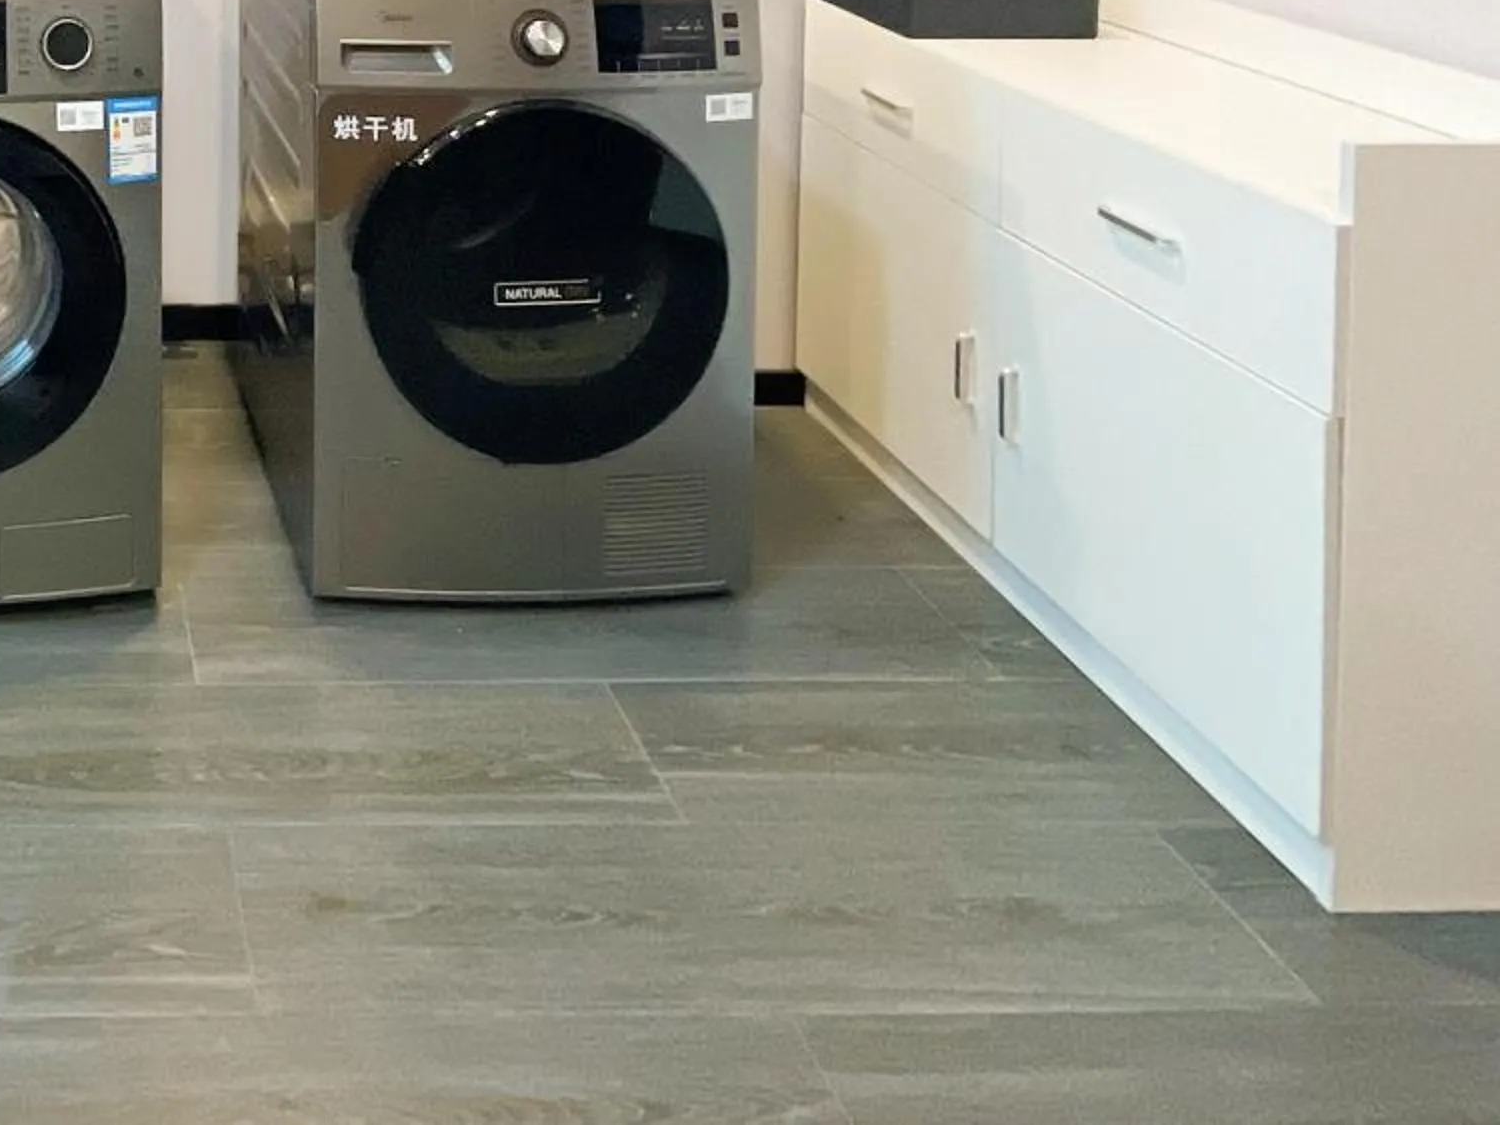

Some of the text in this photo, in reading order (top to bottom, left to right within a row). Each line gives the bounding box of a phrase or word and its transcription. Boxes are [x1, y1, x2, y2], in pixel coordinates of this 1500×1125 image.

[333, 115, 418, 142] 烘干机
[505, 286, 562, 300] NATURAL
